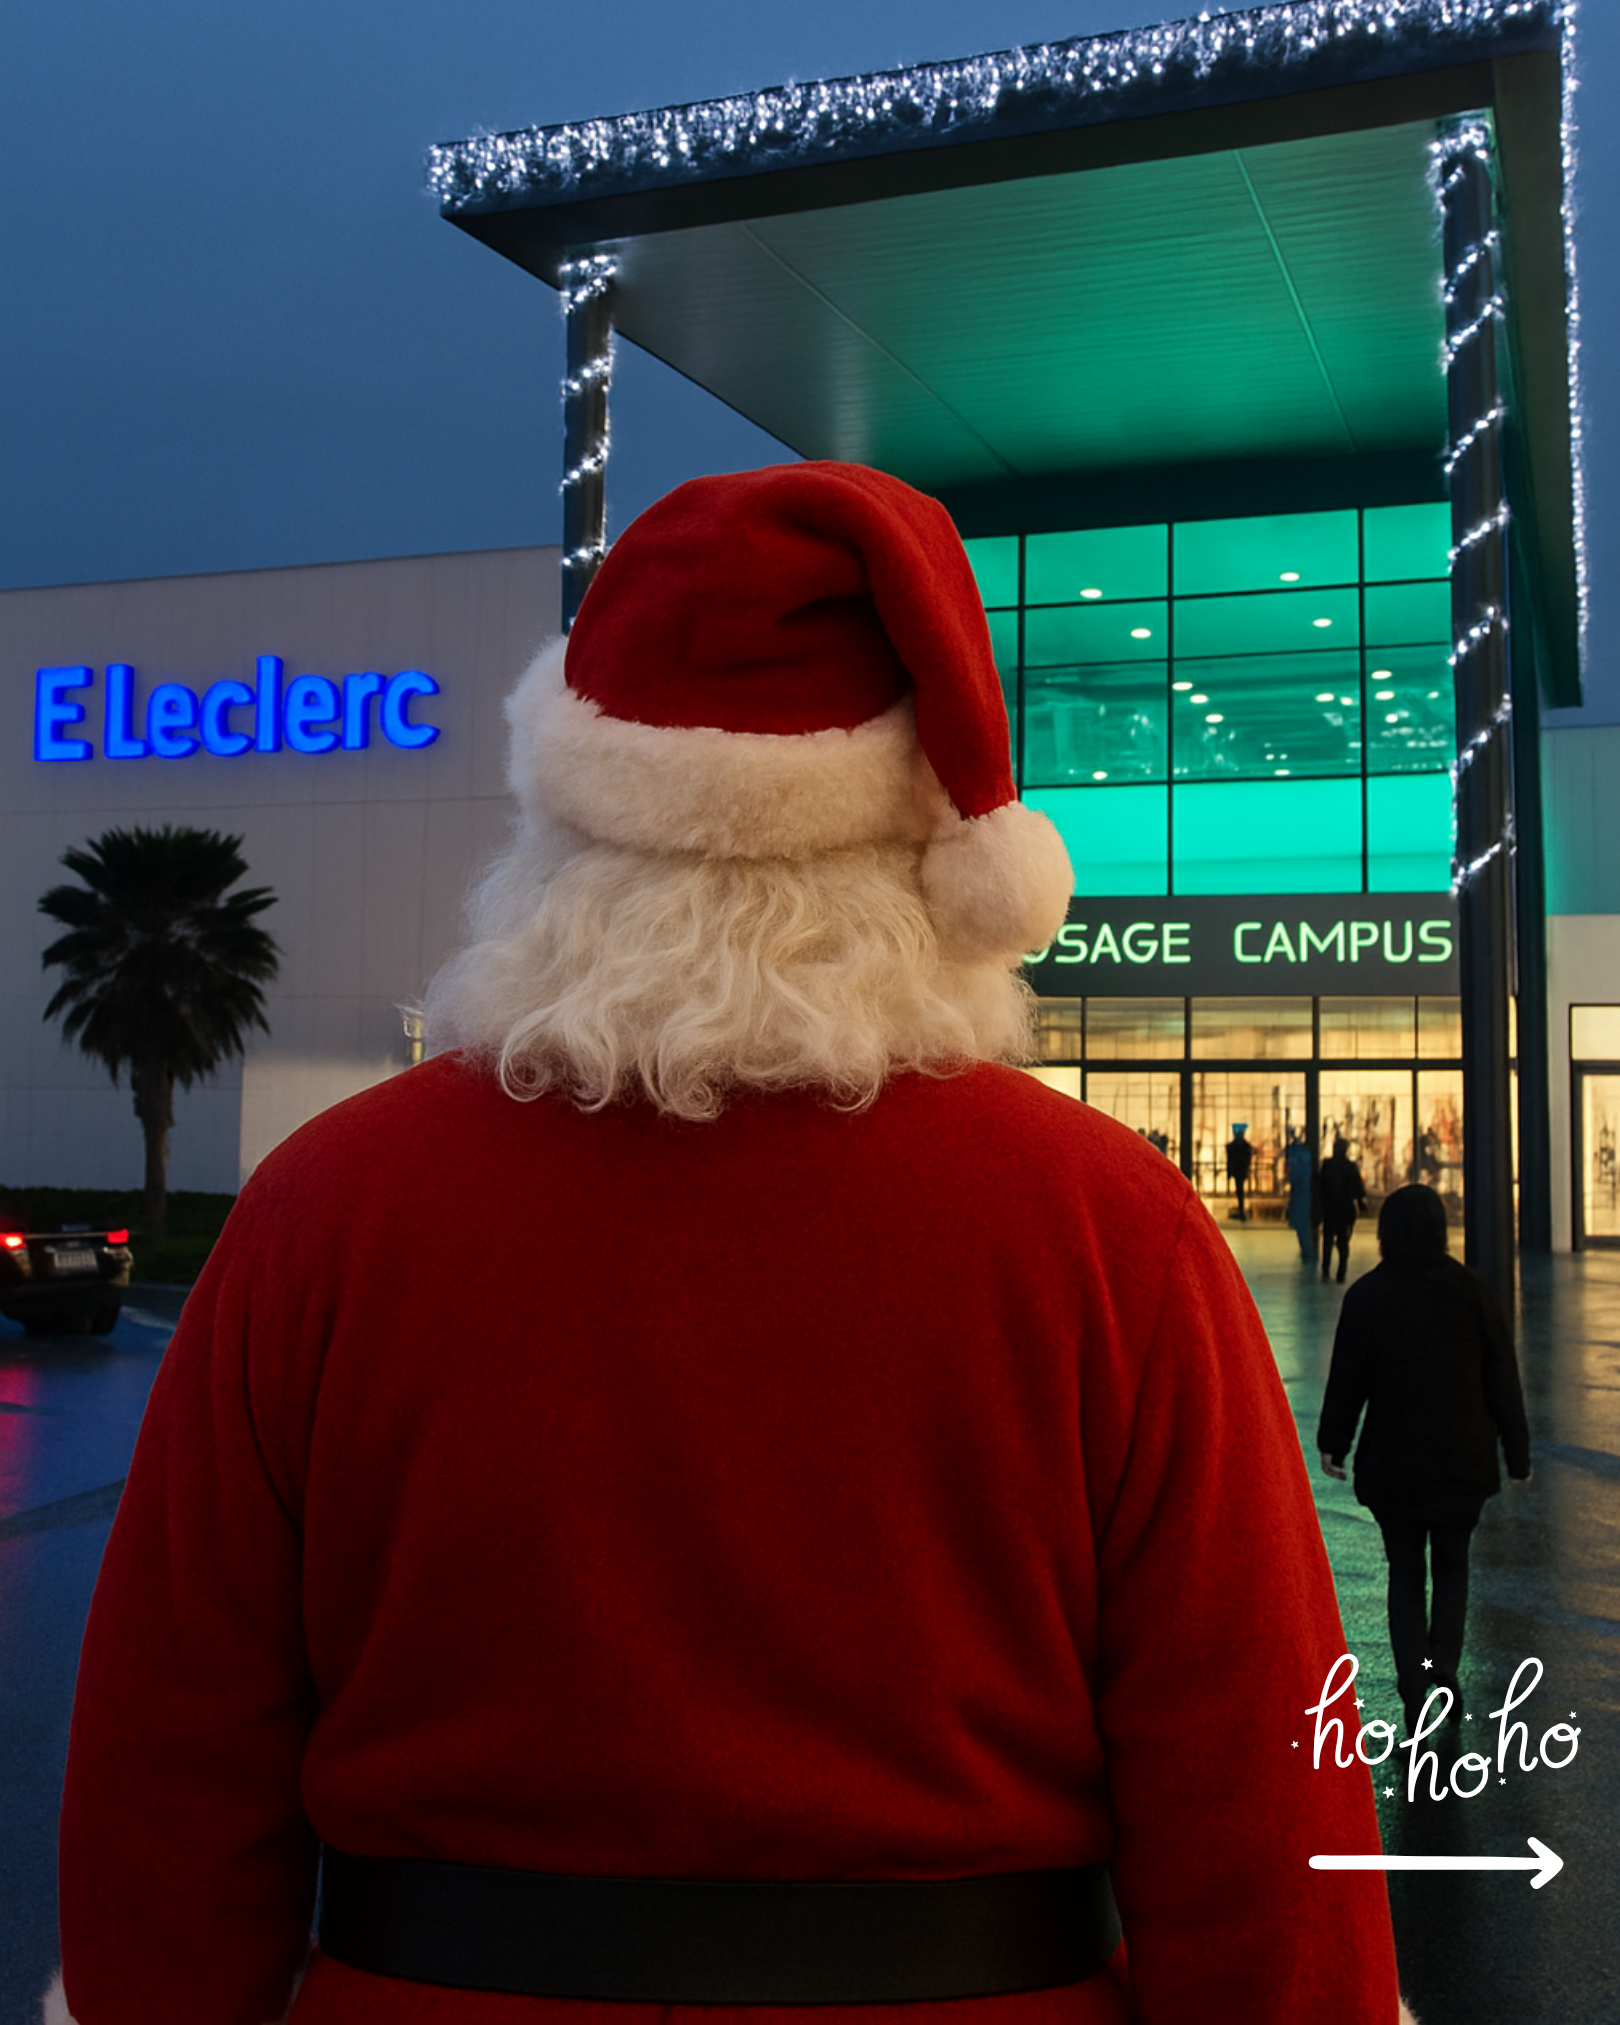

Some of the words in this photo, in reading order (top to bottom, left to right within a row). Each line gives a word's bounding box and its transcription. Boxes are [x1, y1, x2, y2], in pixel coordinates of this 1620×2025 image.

[34, 665, 93, 762] E
[104, 655, 440, 759] Leclerc
[1022, 921, 1191, 964] SAGE
[1233, 919, 1453, 964] CAMPUS
